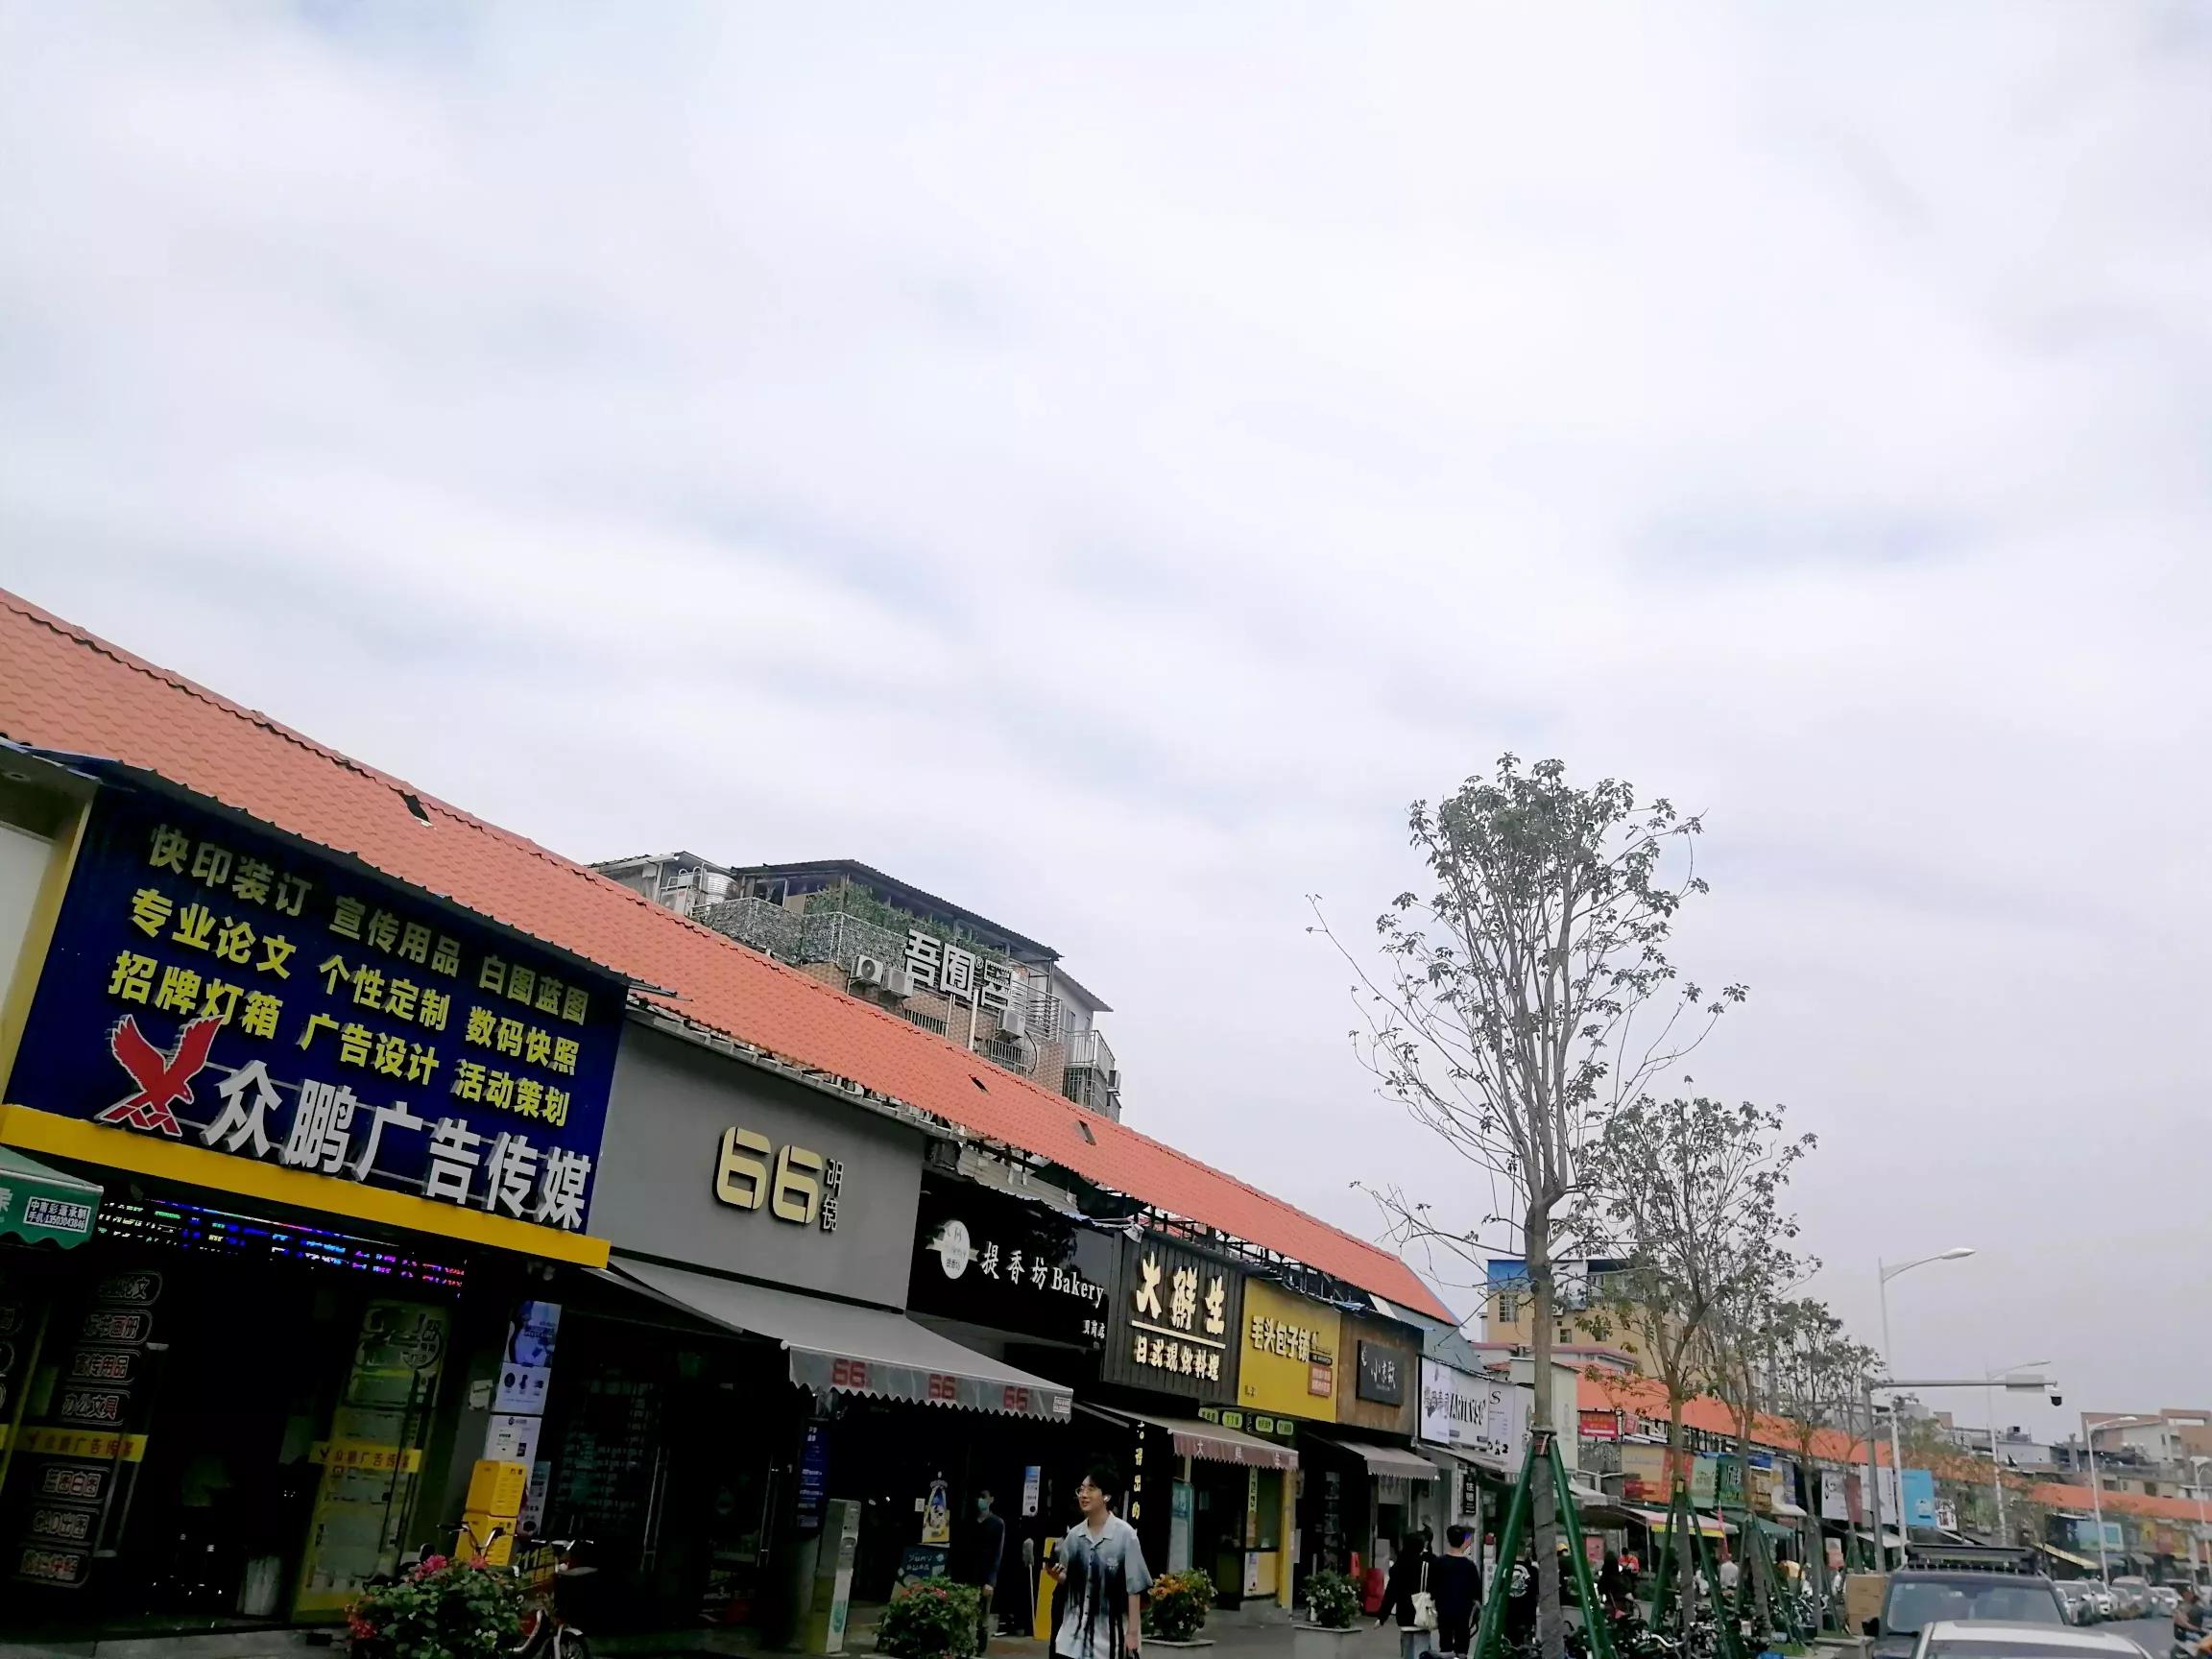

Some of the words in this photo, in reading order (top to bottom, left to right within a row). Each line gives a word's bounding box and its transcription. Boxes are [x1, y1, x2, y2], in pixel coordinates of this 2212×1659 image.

[132, 888, 297, 979] 专业论文
[319, 955, 450, 1031] 个性定制
[466, 1006, 580, 1076] 数码快照
[150, 824, 313, 917] 快印装订
[329, 895, 461, 977] 宣传用品
[479, 954, 589, 1026] 白图蓝图
[108, 950, 283, 1040] 招牌灯箱
[298, 1013, 440, 1086] 广告设计
[450, 1059, 570, 1127] 活动策划
[201, 1059, 592, 1230] 众鹏广告传媒
[716, 1126, 823, 1224] 66
[980, 1241, 1047, 1290] 提香坊
[1051, 1266, 1104, 1309] Bakery
[1251, 1315, 1310, 1362] 毛头包子铺
